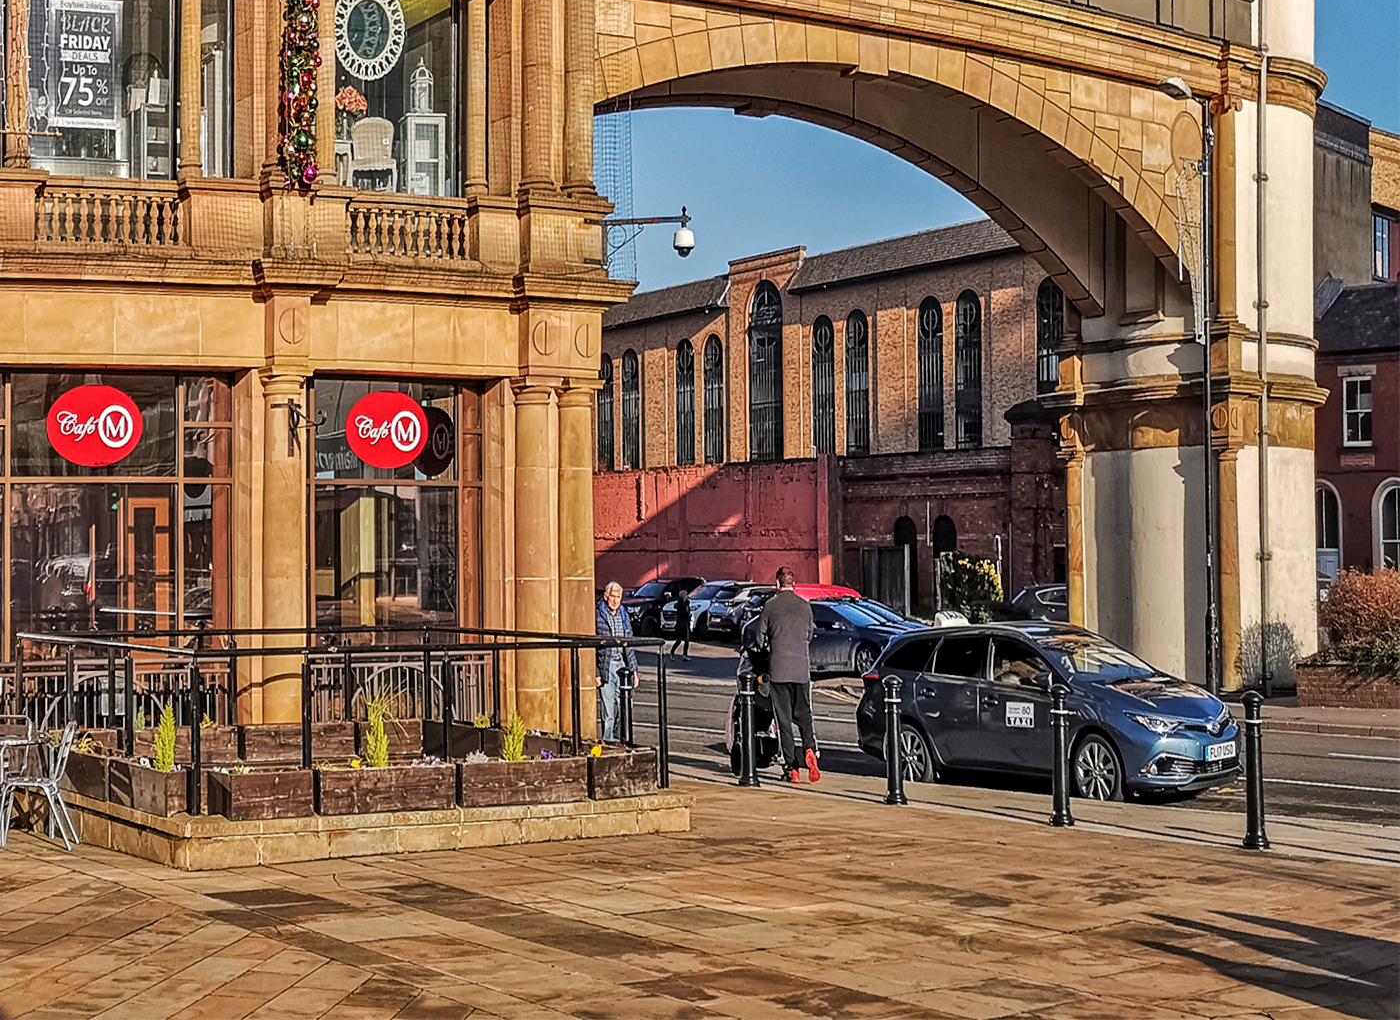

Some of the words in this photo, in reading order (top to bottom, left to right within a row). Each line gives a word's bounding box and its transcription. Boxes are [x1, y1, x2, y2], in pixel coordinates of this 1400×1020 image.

[61, 14, 112, 34] BLACK
[60, 33, 110, 51] FRIDAY
[72, 51, 98, 61] DEALS
[72, 64, 86, 76] Up
[87, 65, 97, 76] To
[56, 411, 99, 442] Café
[354, 415, 391, 445] Café
[1021, 706, 1031, 716] 80
[1009, 717, 1031, 728] TAXI
